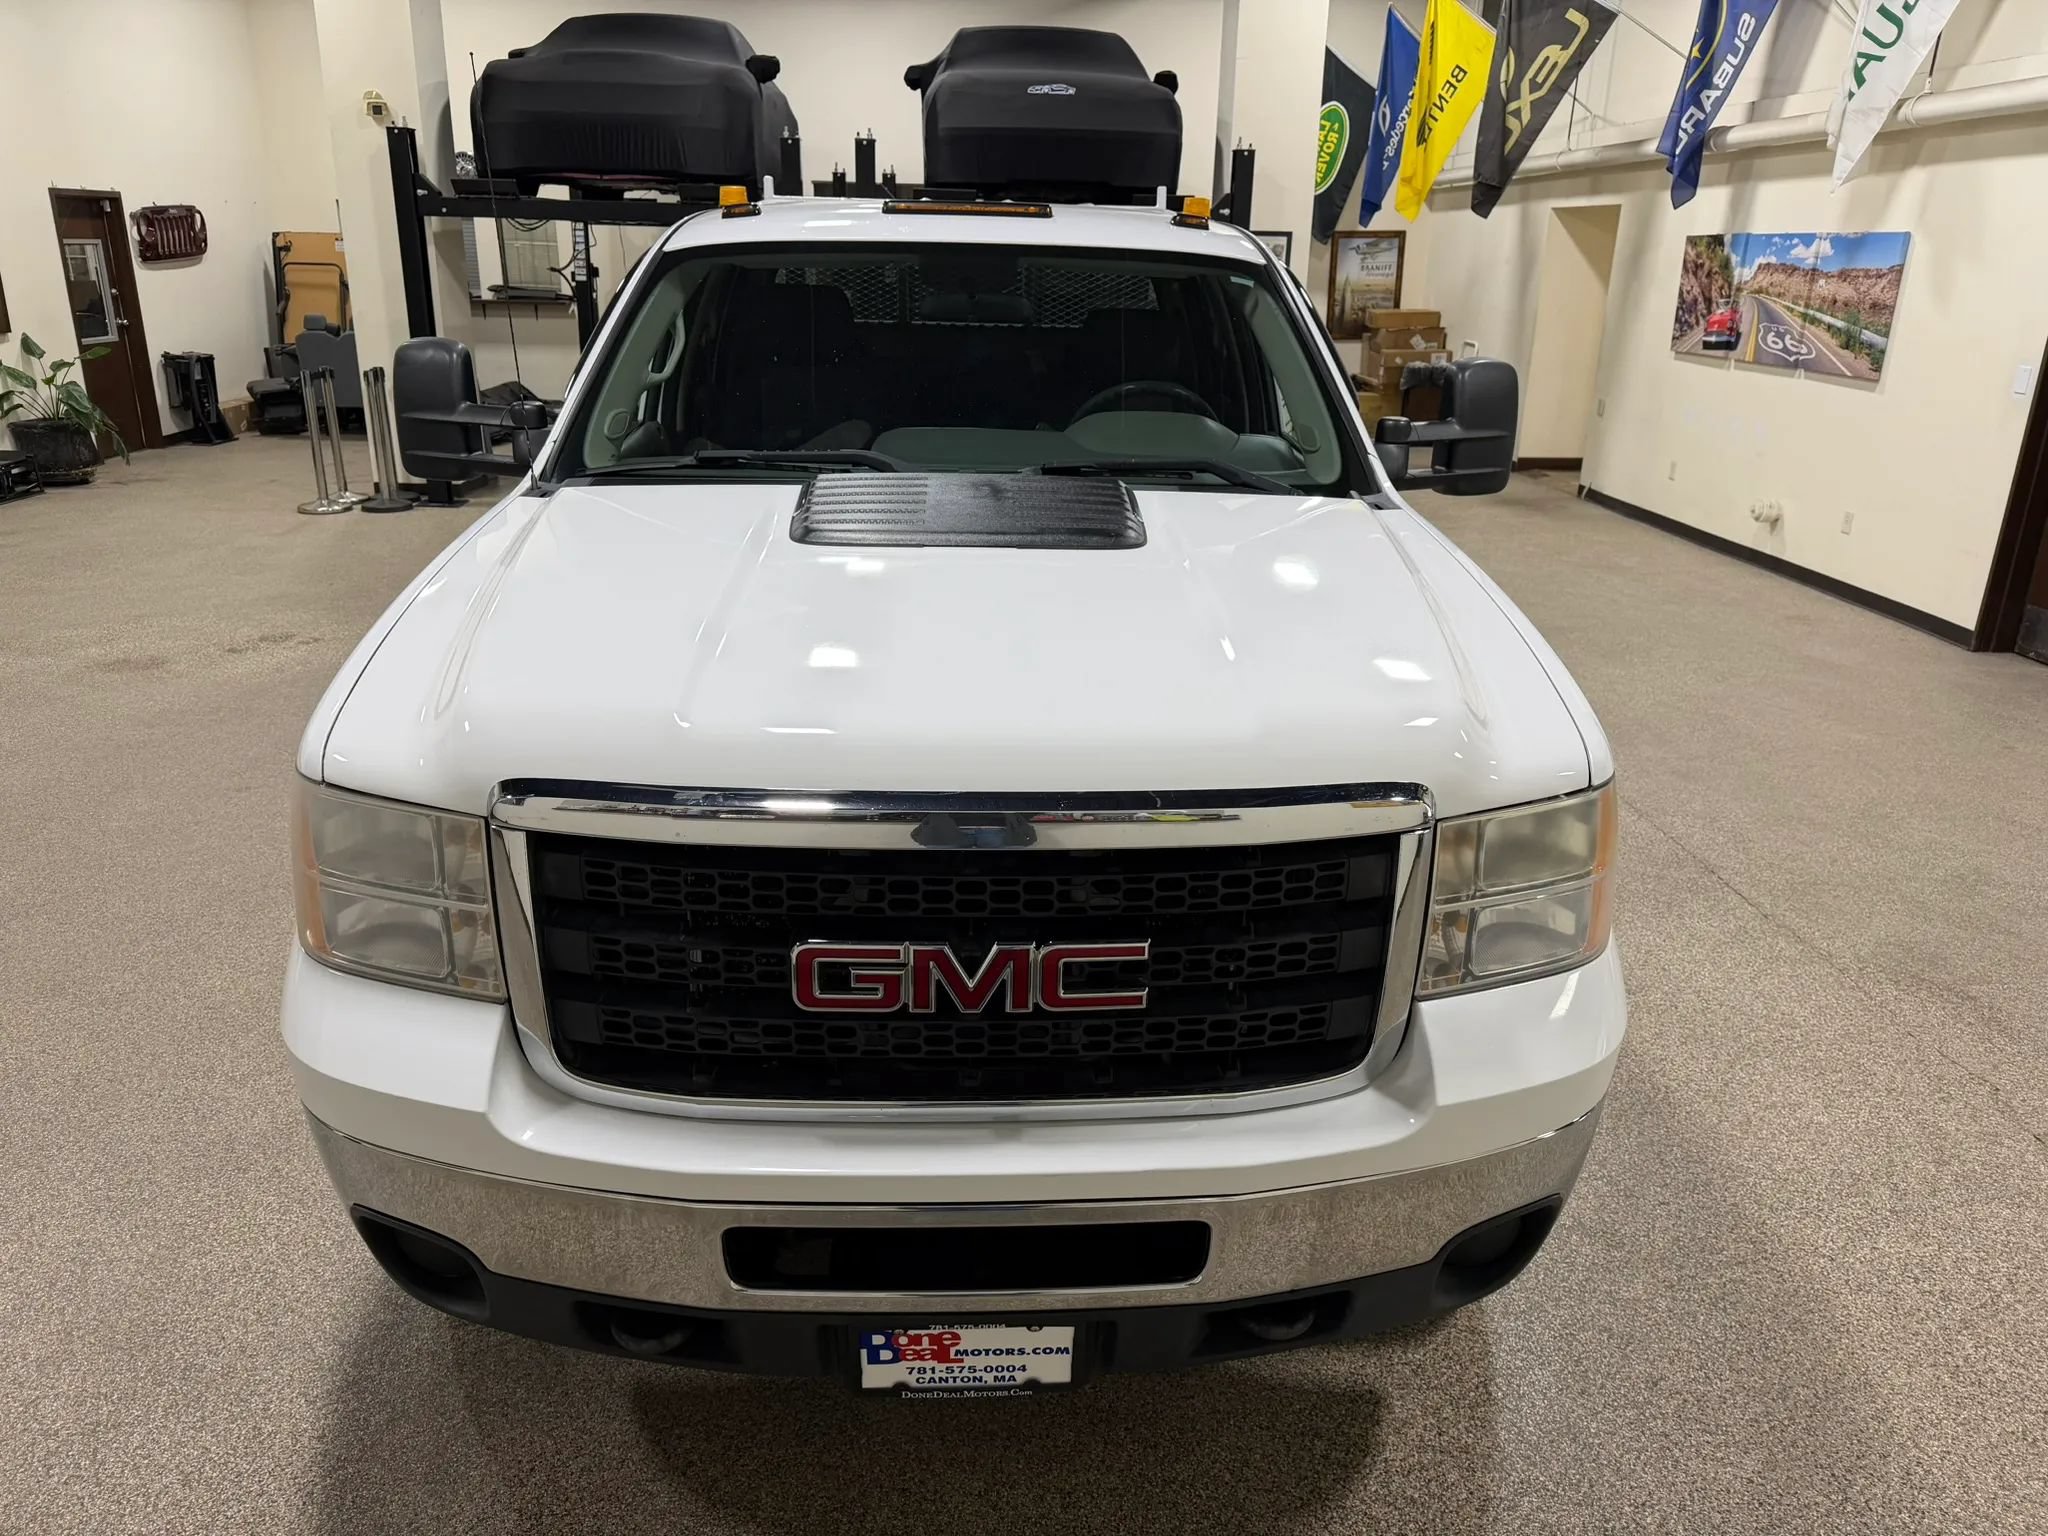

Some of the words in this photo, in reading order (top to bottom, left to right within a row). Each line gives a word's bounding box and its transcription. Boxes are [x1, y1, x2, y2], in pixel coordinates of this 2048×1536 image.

[1766, 331, 1808, 354] 66
[791, 938, 1151, 1013] GMC
[953, 1346, 1071, 1357] MOTORS.COM
[905, 1364, 1027, 1375] 781-575-0004
[915, 1375, 988, 1385] CANTON,
[993, 1375, 1018, 1383] MA
